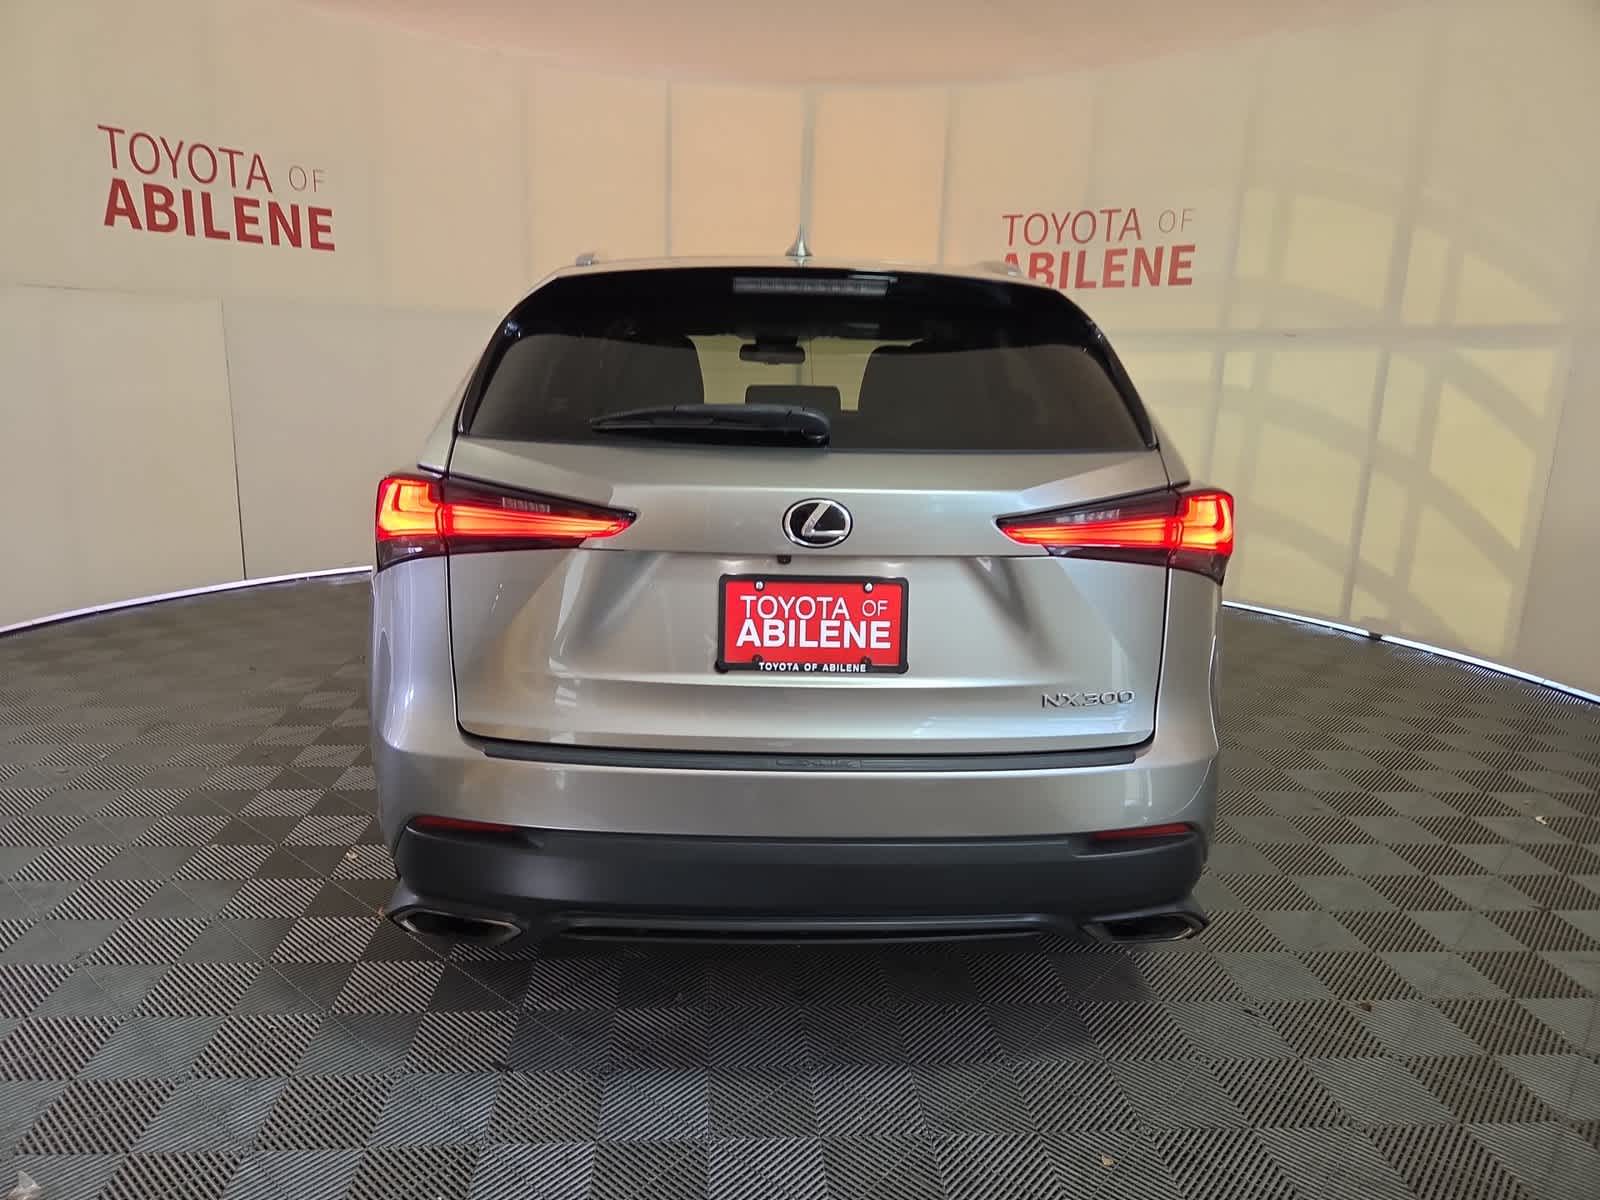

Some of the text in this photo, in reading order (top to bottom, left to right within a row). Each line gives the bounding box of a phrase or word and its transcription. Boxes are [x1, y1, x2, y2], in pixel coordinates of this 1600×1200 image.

[97, 124, 325, 192] TOYOTA OF
[104, 178, 335, 251] ABILENE
[1002, 208, 1195, 246] TOYOTA OF
[740, 596, 888, 619] TOYOTA OF
[736, 619, 891, 648] ABILENE
[759, 662, 866, 672] TOYOTA OF ABILENE
